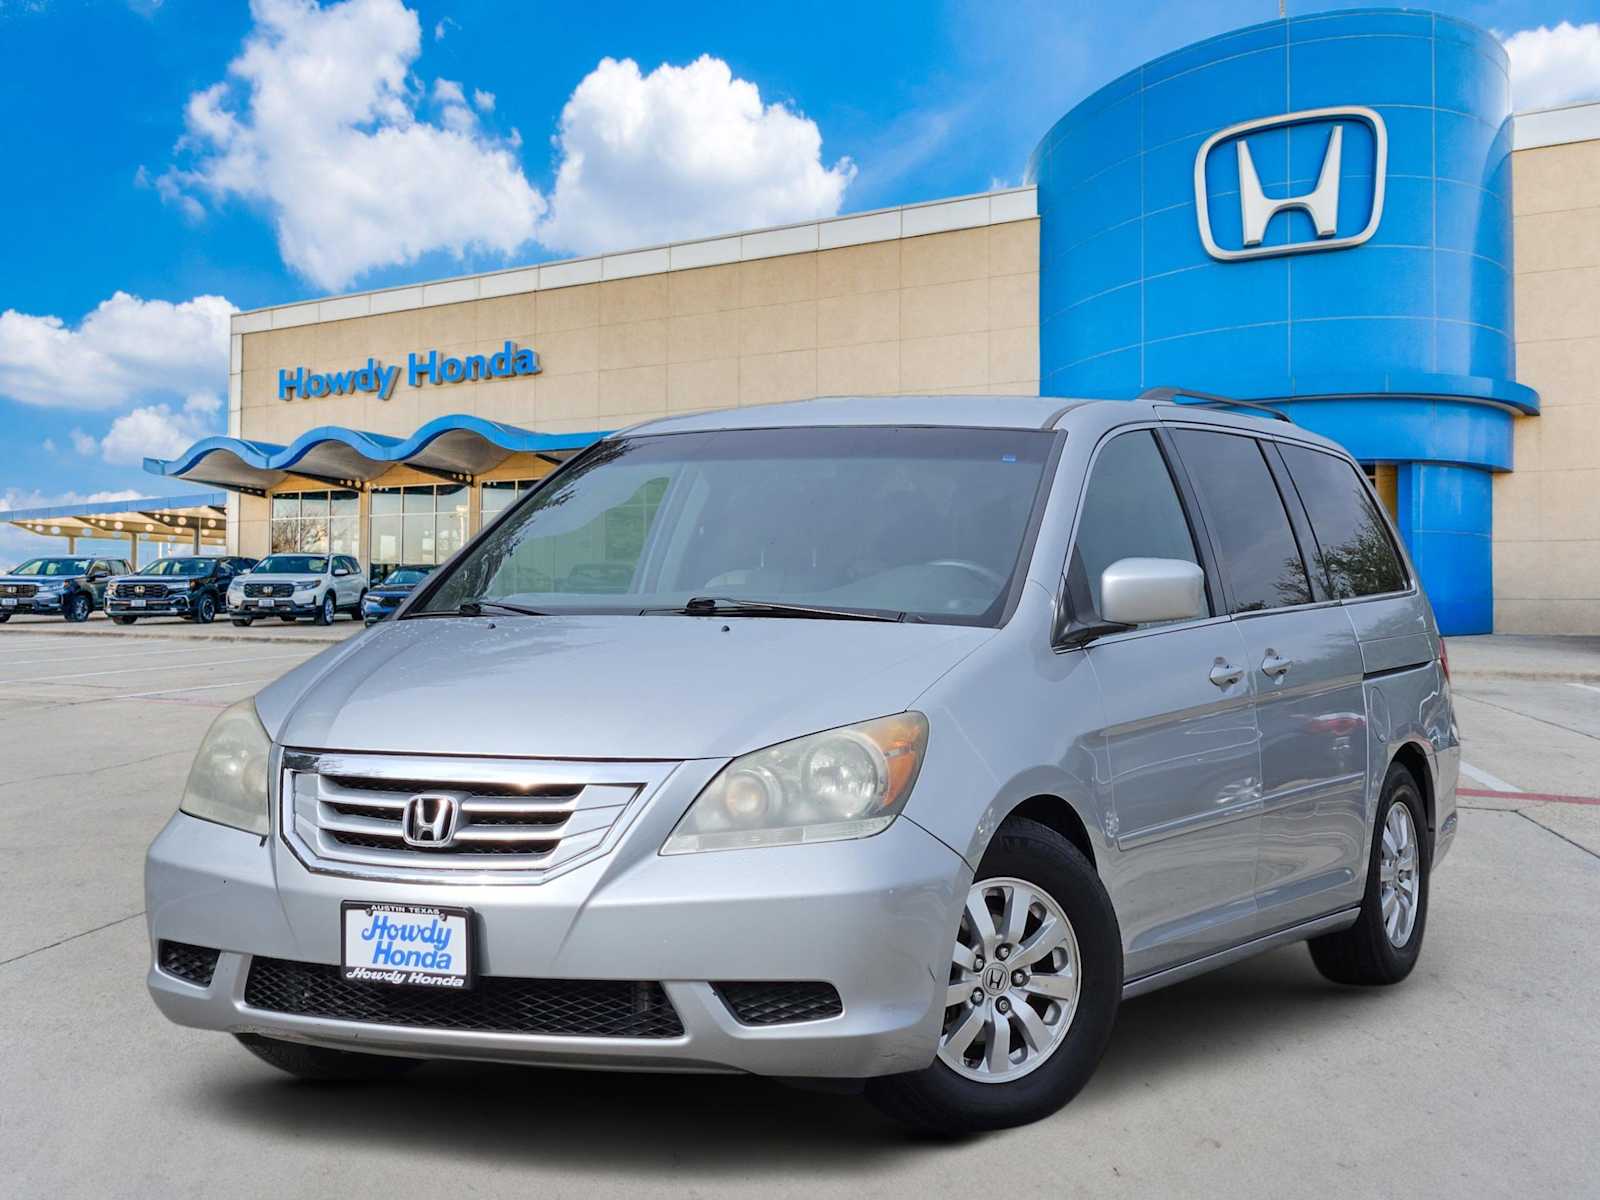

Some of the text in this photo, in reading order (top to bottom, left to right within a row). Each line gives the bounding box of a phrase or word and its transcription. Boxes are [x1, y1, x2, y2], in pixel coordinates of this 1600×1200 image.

[278, 340, 542, 401] Howdy Honda
[370, 904, 441, 915] AUSTIN TEXAS
[361, 914, 453, 950] Howdy
[372, 940, 453, 970] Honda
[346, 967, 465, 987] Howdy Honda
